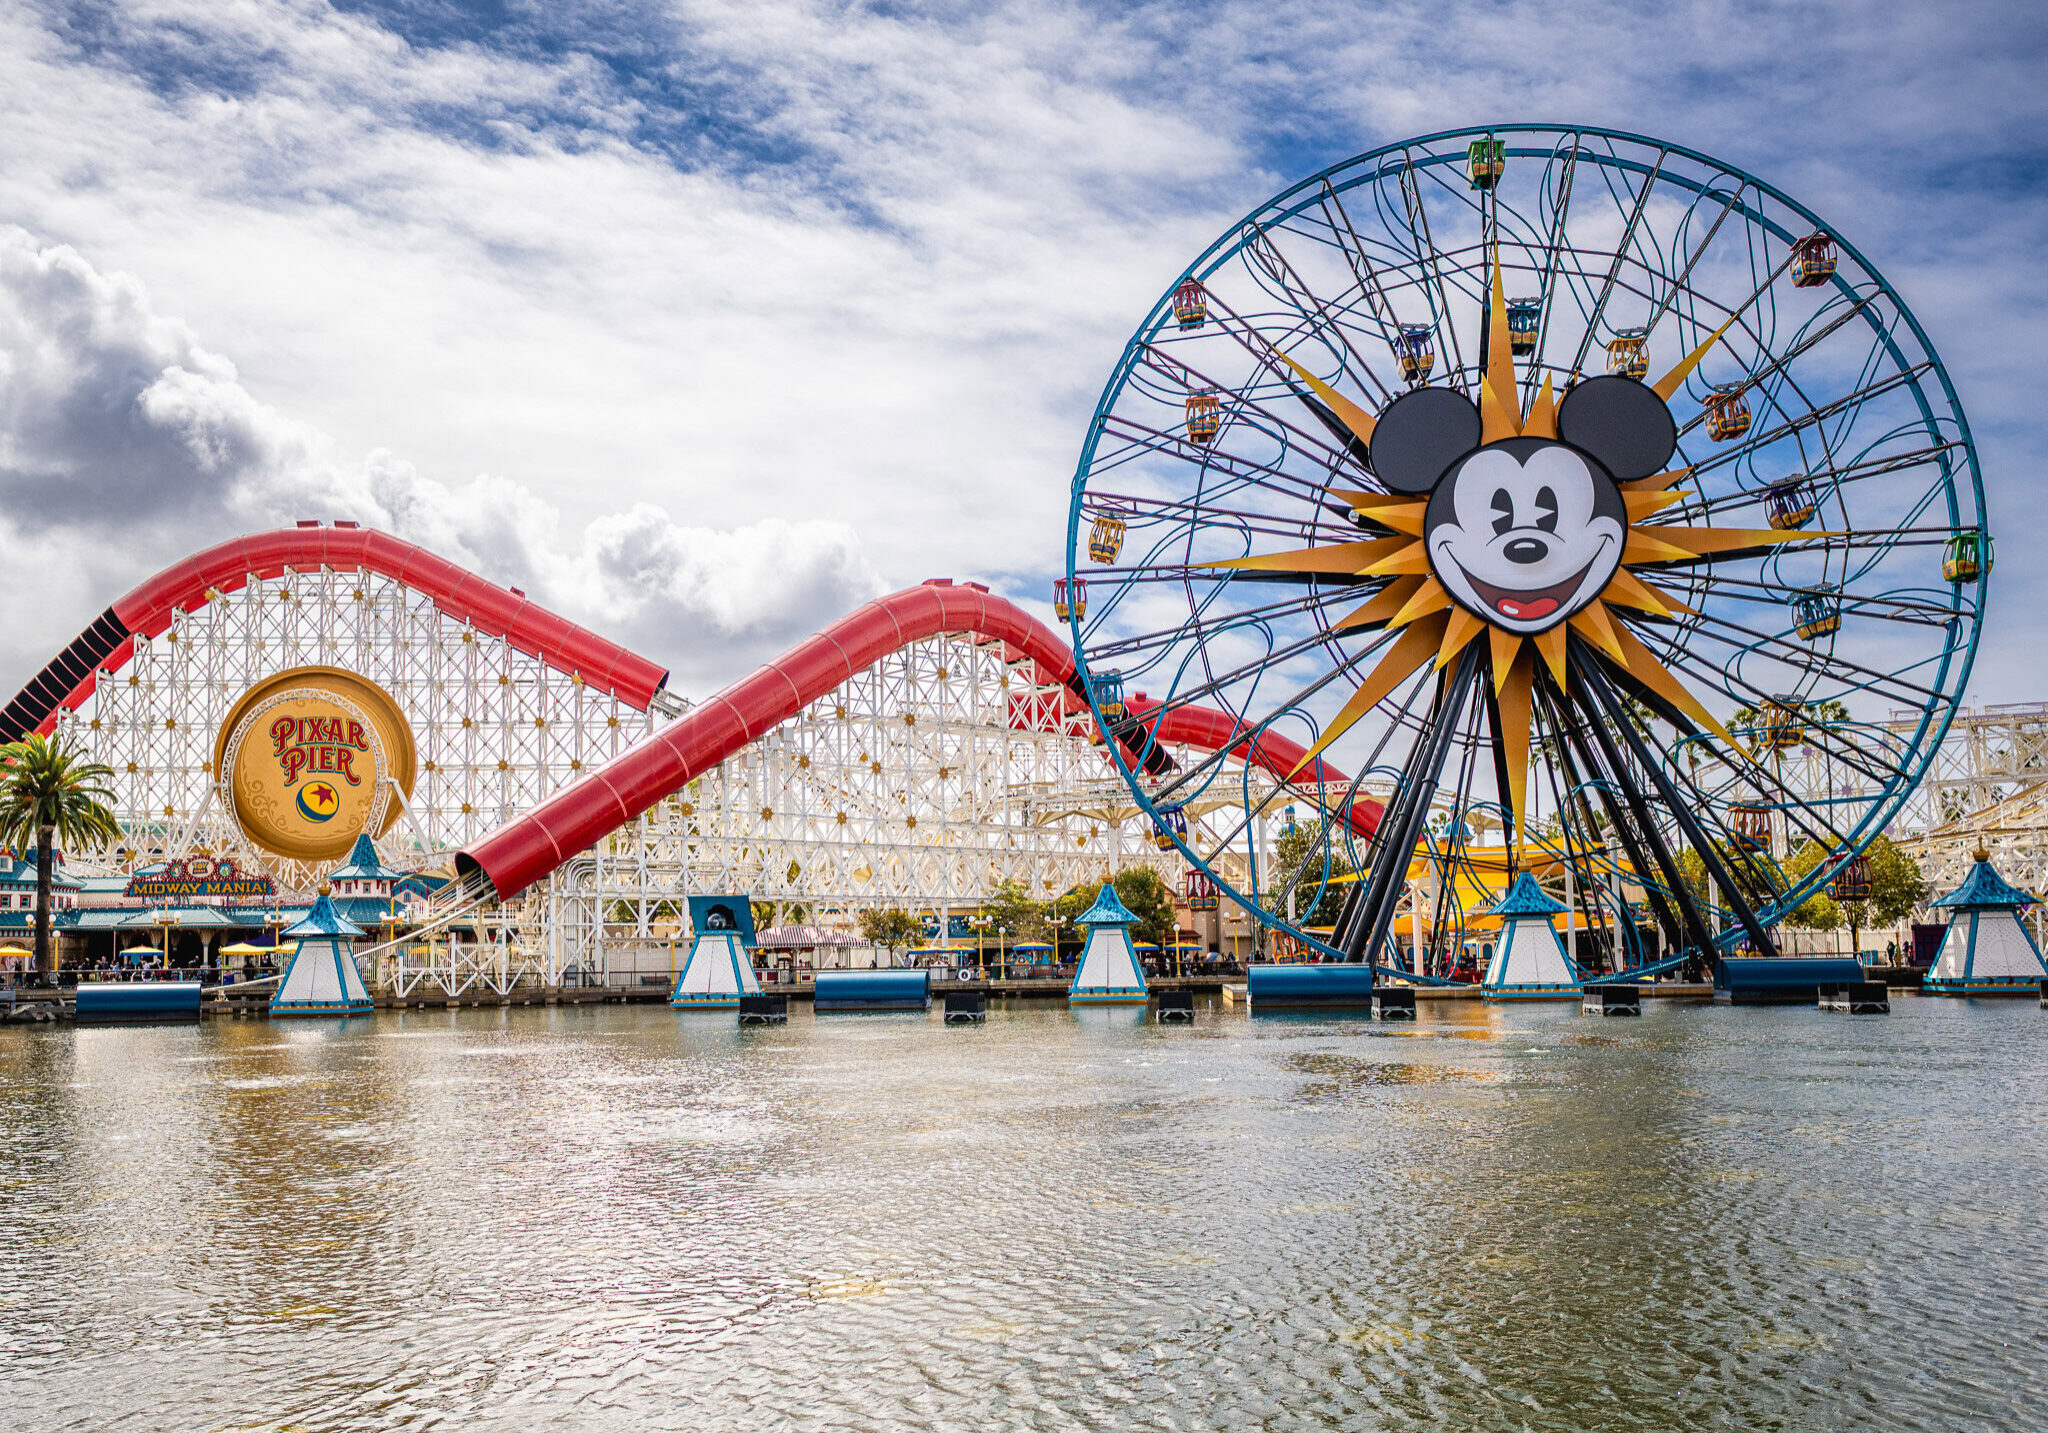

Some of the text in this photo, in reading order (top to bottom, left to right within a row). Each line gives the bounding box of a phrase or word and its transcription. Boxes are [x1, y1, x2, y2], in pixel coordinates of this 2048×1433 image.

[269, 716, 369, 756] PIXAR
[280, 746, 361, 786] PIER
[133, 882, 267, 894] MIDWAY MANIA!
